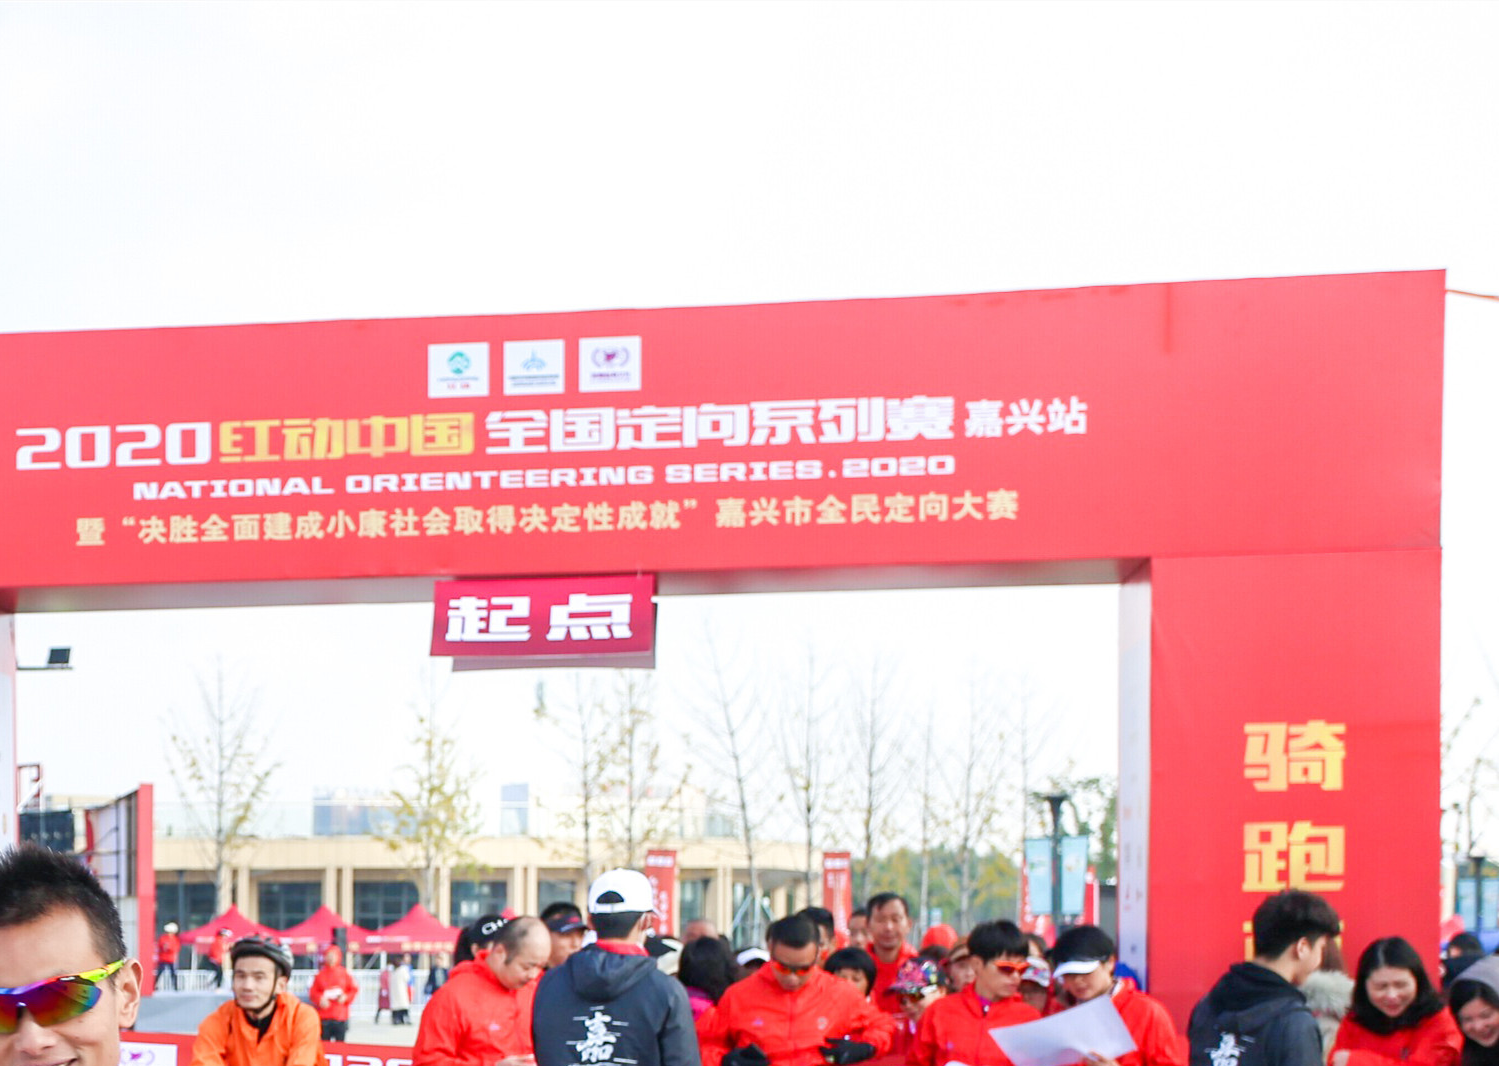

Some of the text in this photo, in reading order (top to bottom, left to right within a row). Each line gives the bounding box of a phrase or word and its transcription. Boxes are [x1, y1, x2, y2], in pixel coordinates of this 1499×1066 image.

[965, 396, 1087, 438] 嘉兴站
[133, 477, 334, 501] NATIONAL
[345, 465, 654, 494] ORIENTEERING
[715, 488, 1019, 529] 嘉兴市全民定向大赛
[445, 593, 633, 642] 起点
